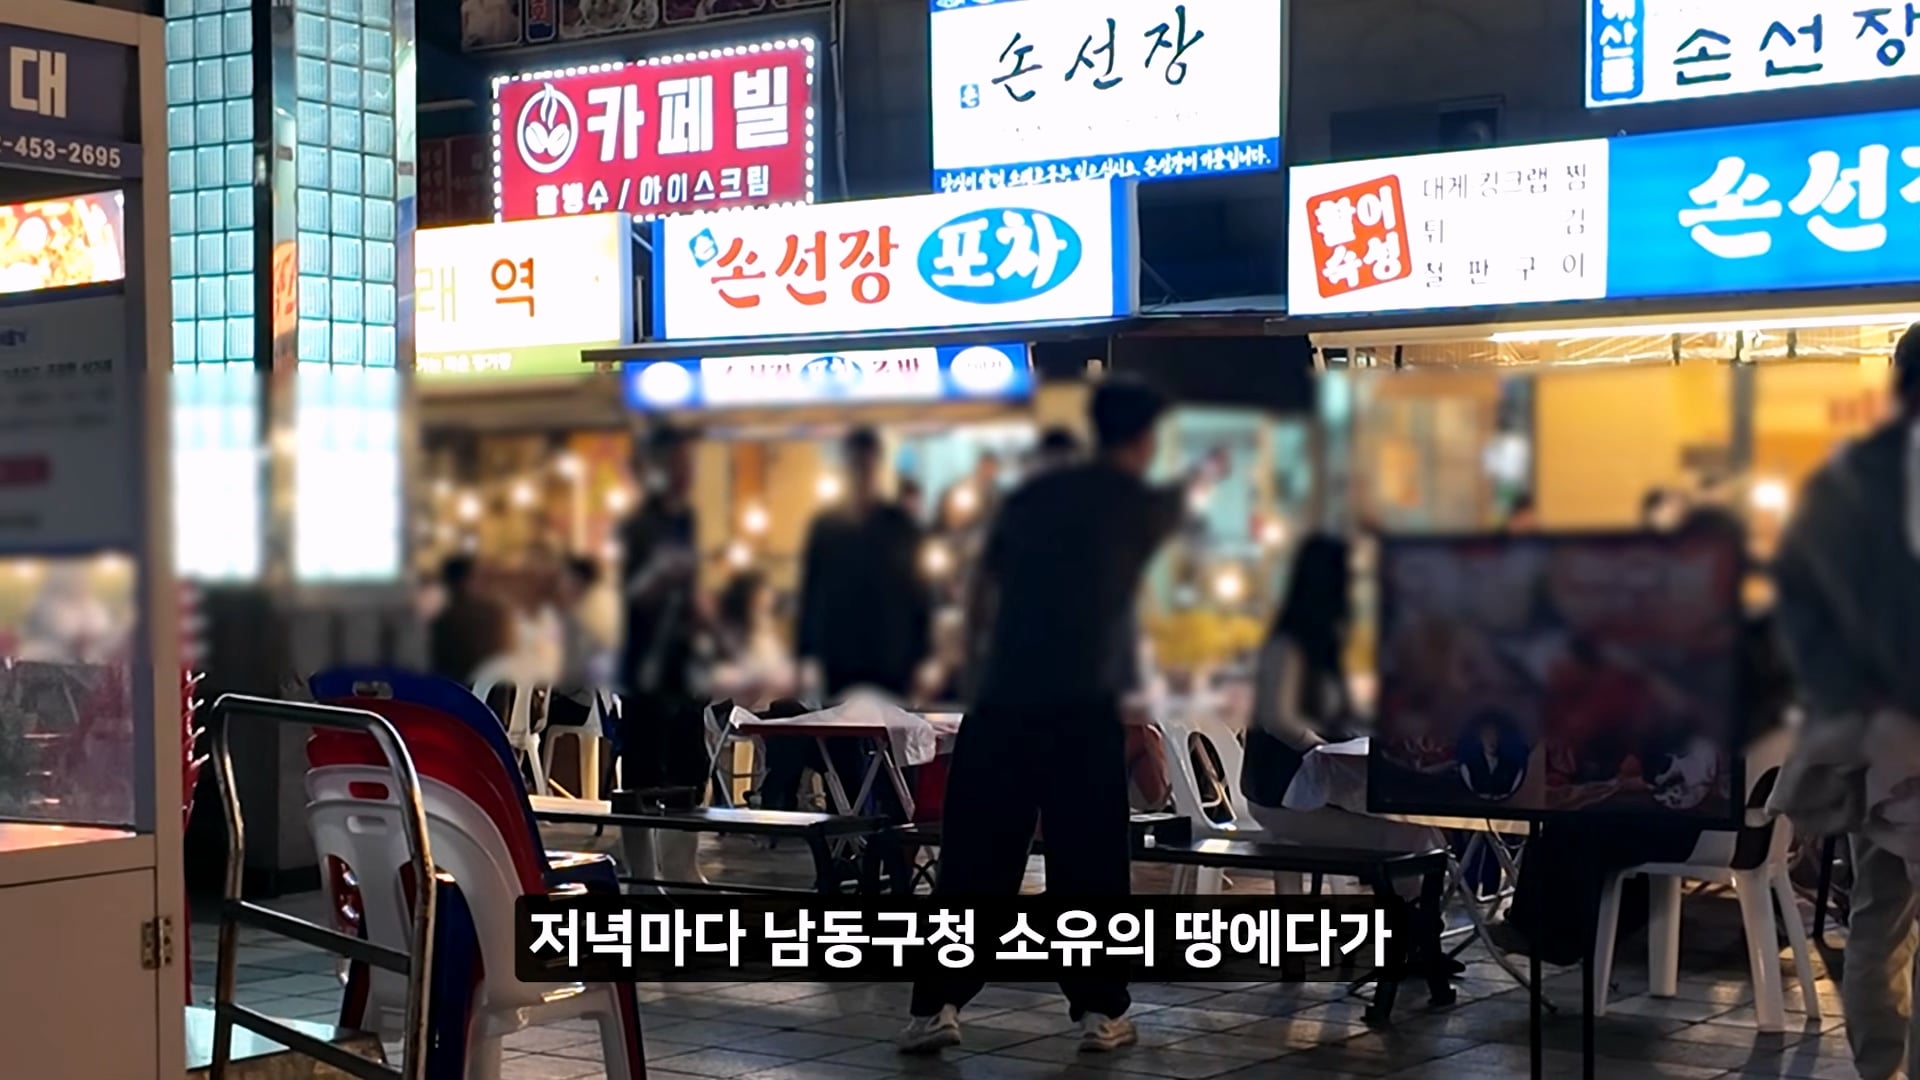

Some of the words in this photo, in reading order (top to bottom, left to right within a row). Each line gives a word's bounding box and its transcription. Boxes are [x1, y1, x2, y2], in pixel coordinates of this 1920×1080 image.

[10, 46, 67, 118] 대
[991, 5, 1205, 101] 손선장
[1673, 2, 1920, 86] 손선장
[0, 135, 121, 168] -453-2695
[586, 65, 789, 162] 카페빌
[639, 164, 769, 206] 아이스크림
[711, 225, 899, 309] 손선장
[931, 210, 1067, 290] 포차
